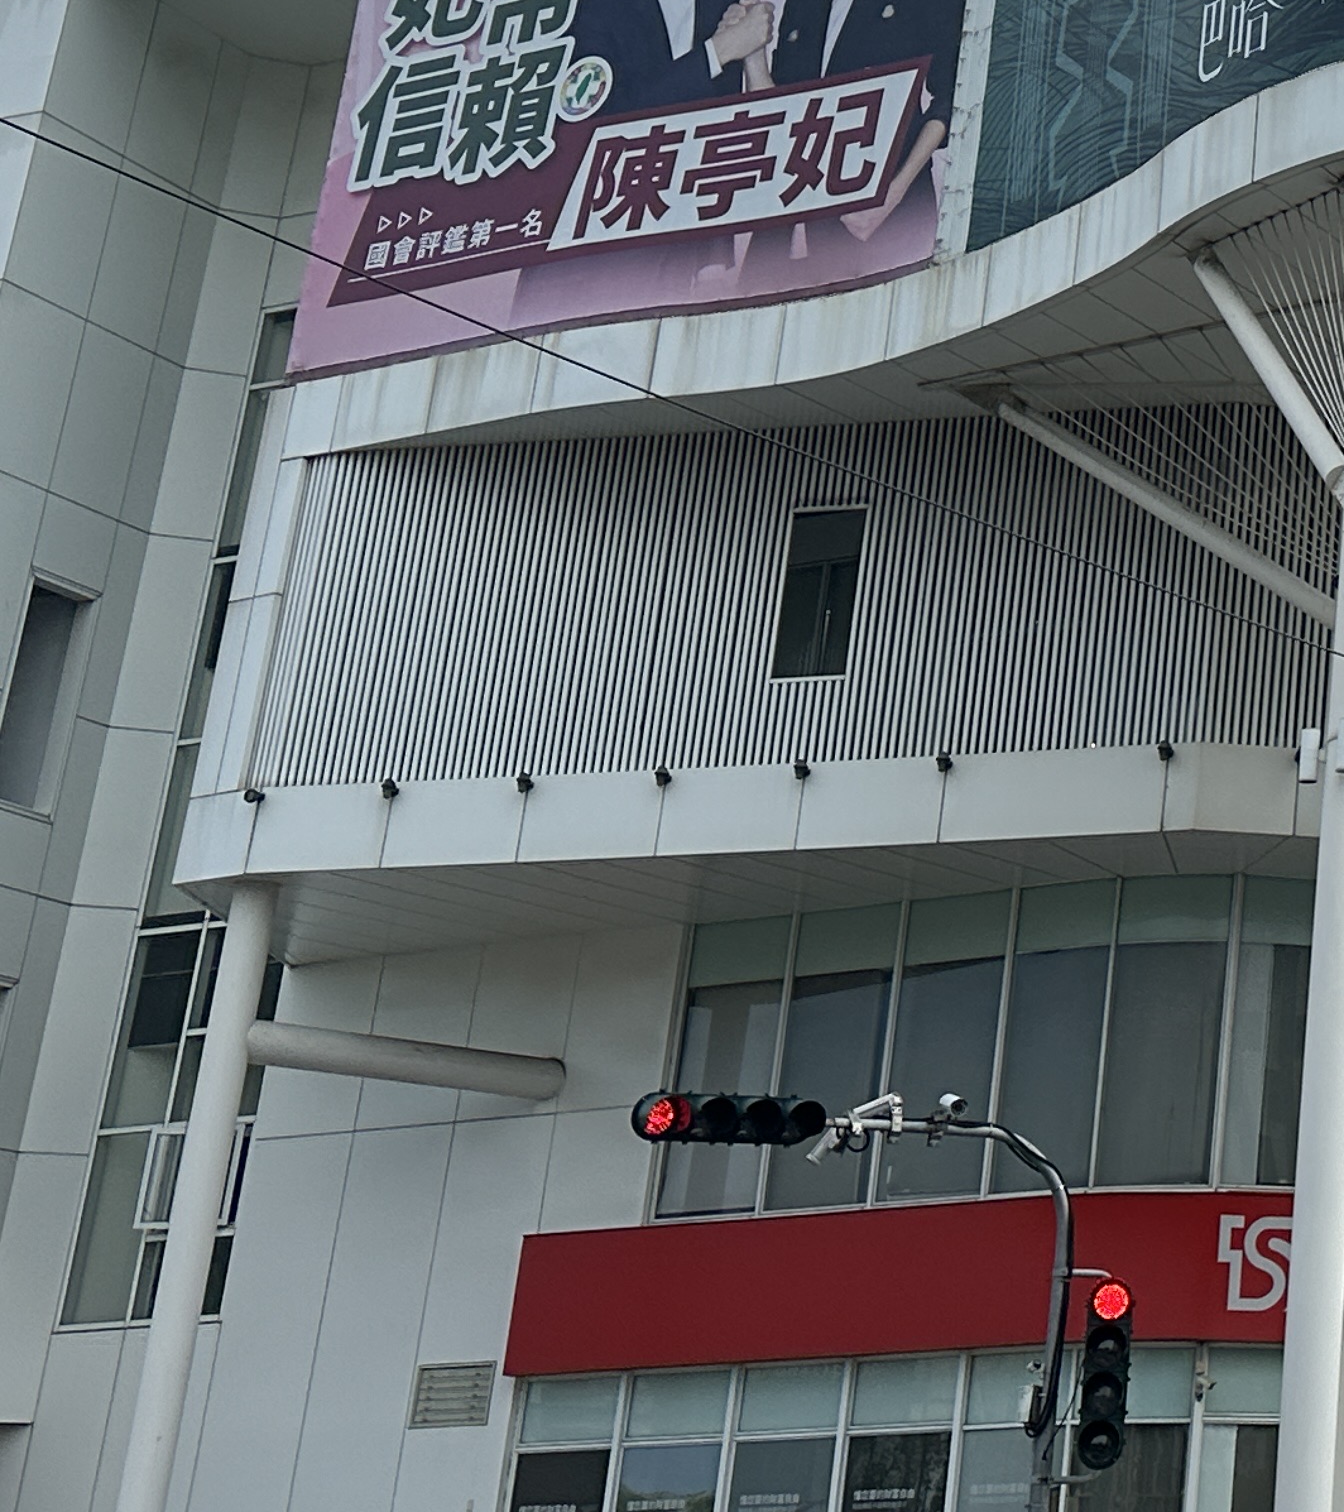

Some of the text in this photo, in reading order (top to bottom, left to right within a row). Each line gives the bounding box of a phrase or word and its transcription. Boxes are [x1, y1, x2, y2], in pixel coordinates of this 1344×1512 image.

[354, 41, 574, 186] 信賴
[573, 86, 884, 240] 陳亭妃
[363, 208, 543, 271] 國會評鑑第一名
